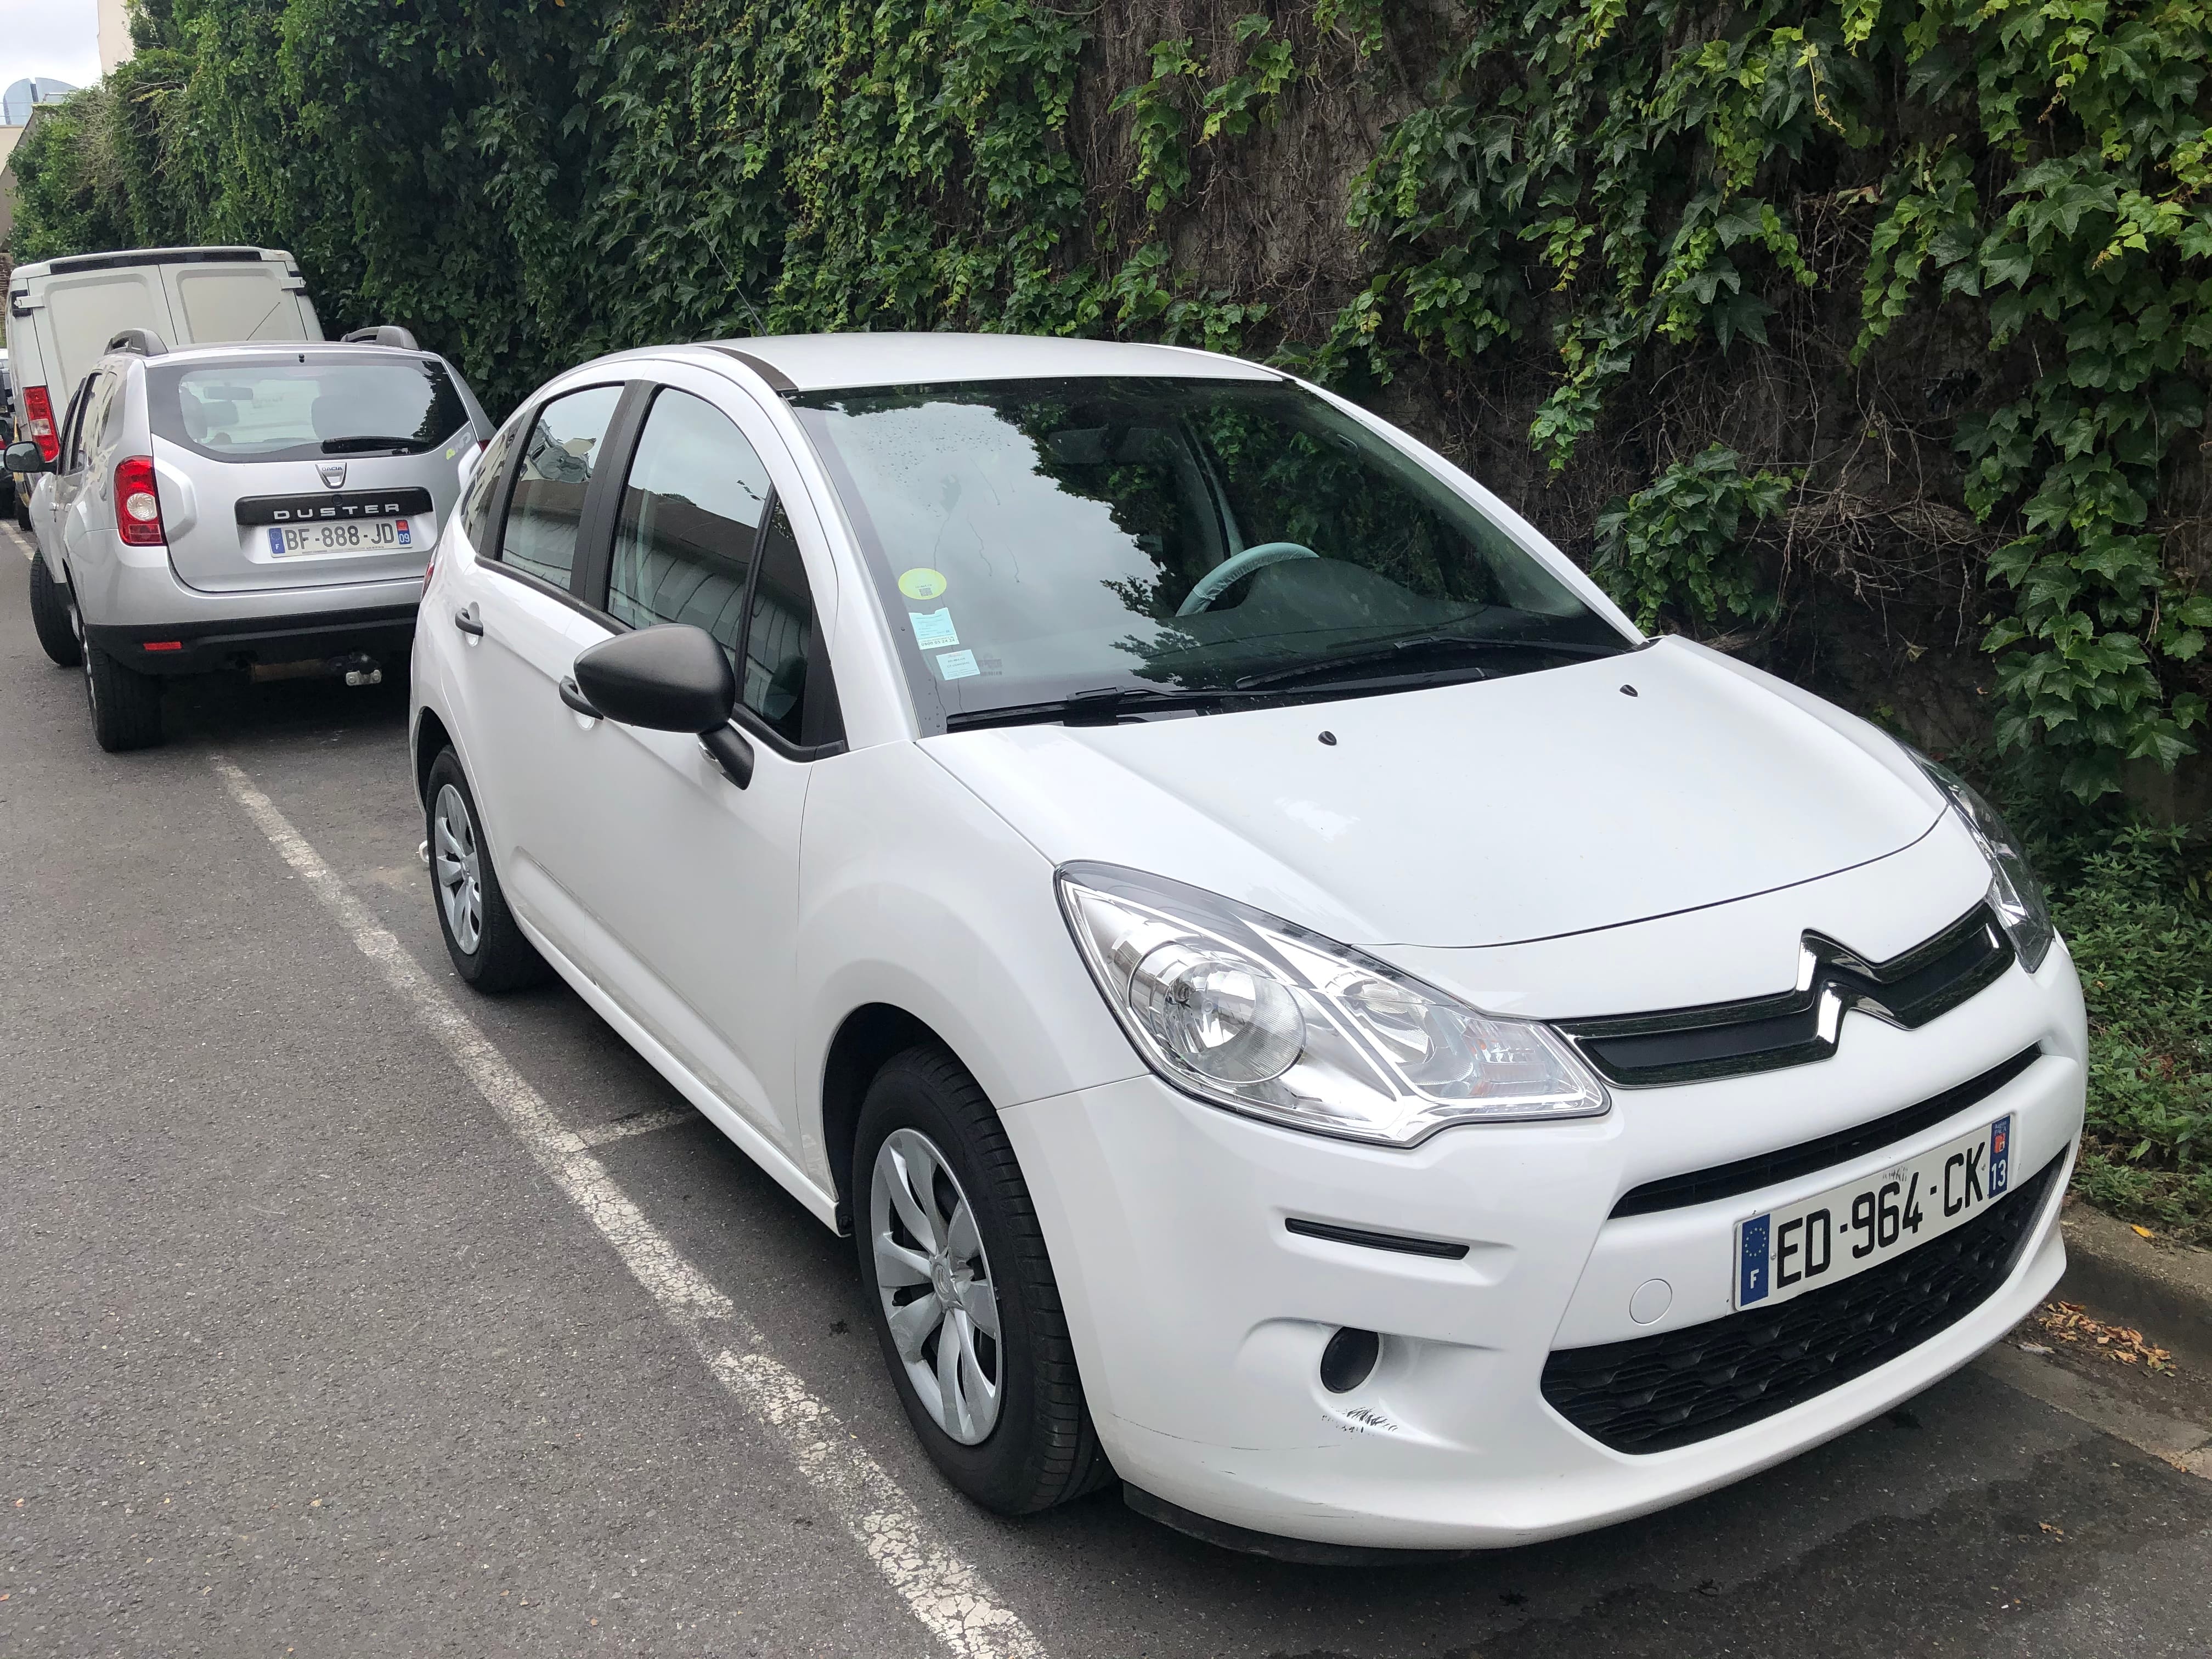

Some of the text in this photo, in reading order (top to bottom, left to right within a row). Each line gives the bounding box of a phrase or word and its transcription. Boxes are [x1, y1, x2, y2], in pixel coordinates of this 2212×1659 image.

[273, 504, 399, 520] DUSTER
[285, 523, 394, 550] BF-888-JD
[398, 533, 411, 543] 09
[1750, 1141, 2006, 1289] F ED-964-CK 13
